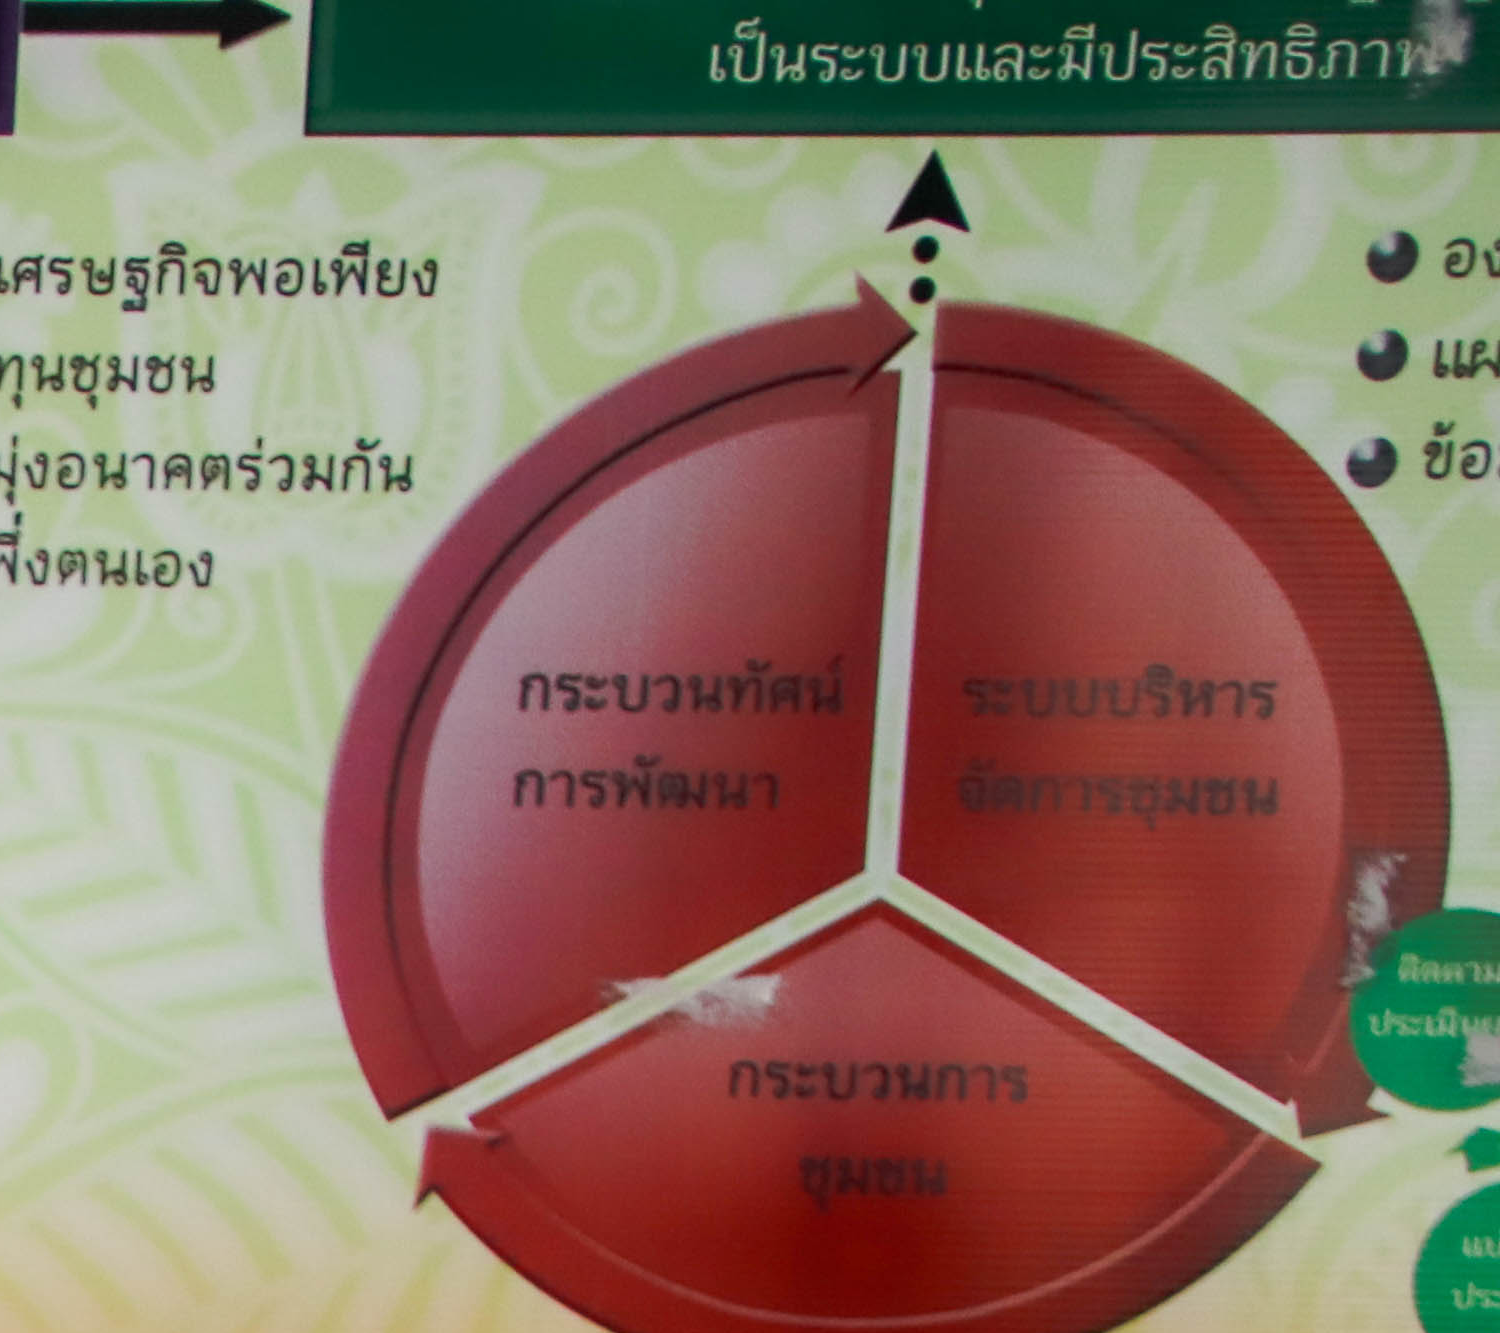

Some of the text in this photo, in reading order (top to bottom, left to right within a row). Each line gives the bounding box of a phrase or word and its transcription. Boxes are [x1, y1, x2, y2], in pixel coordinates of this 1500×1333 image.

[518, 654, 844, 714] กระบวนทัศน์
[962, 663, 1278, 720] ระบบบริหาร
[729, 1059, 1029, 1105] กระบวนการ
